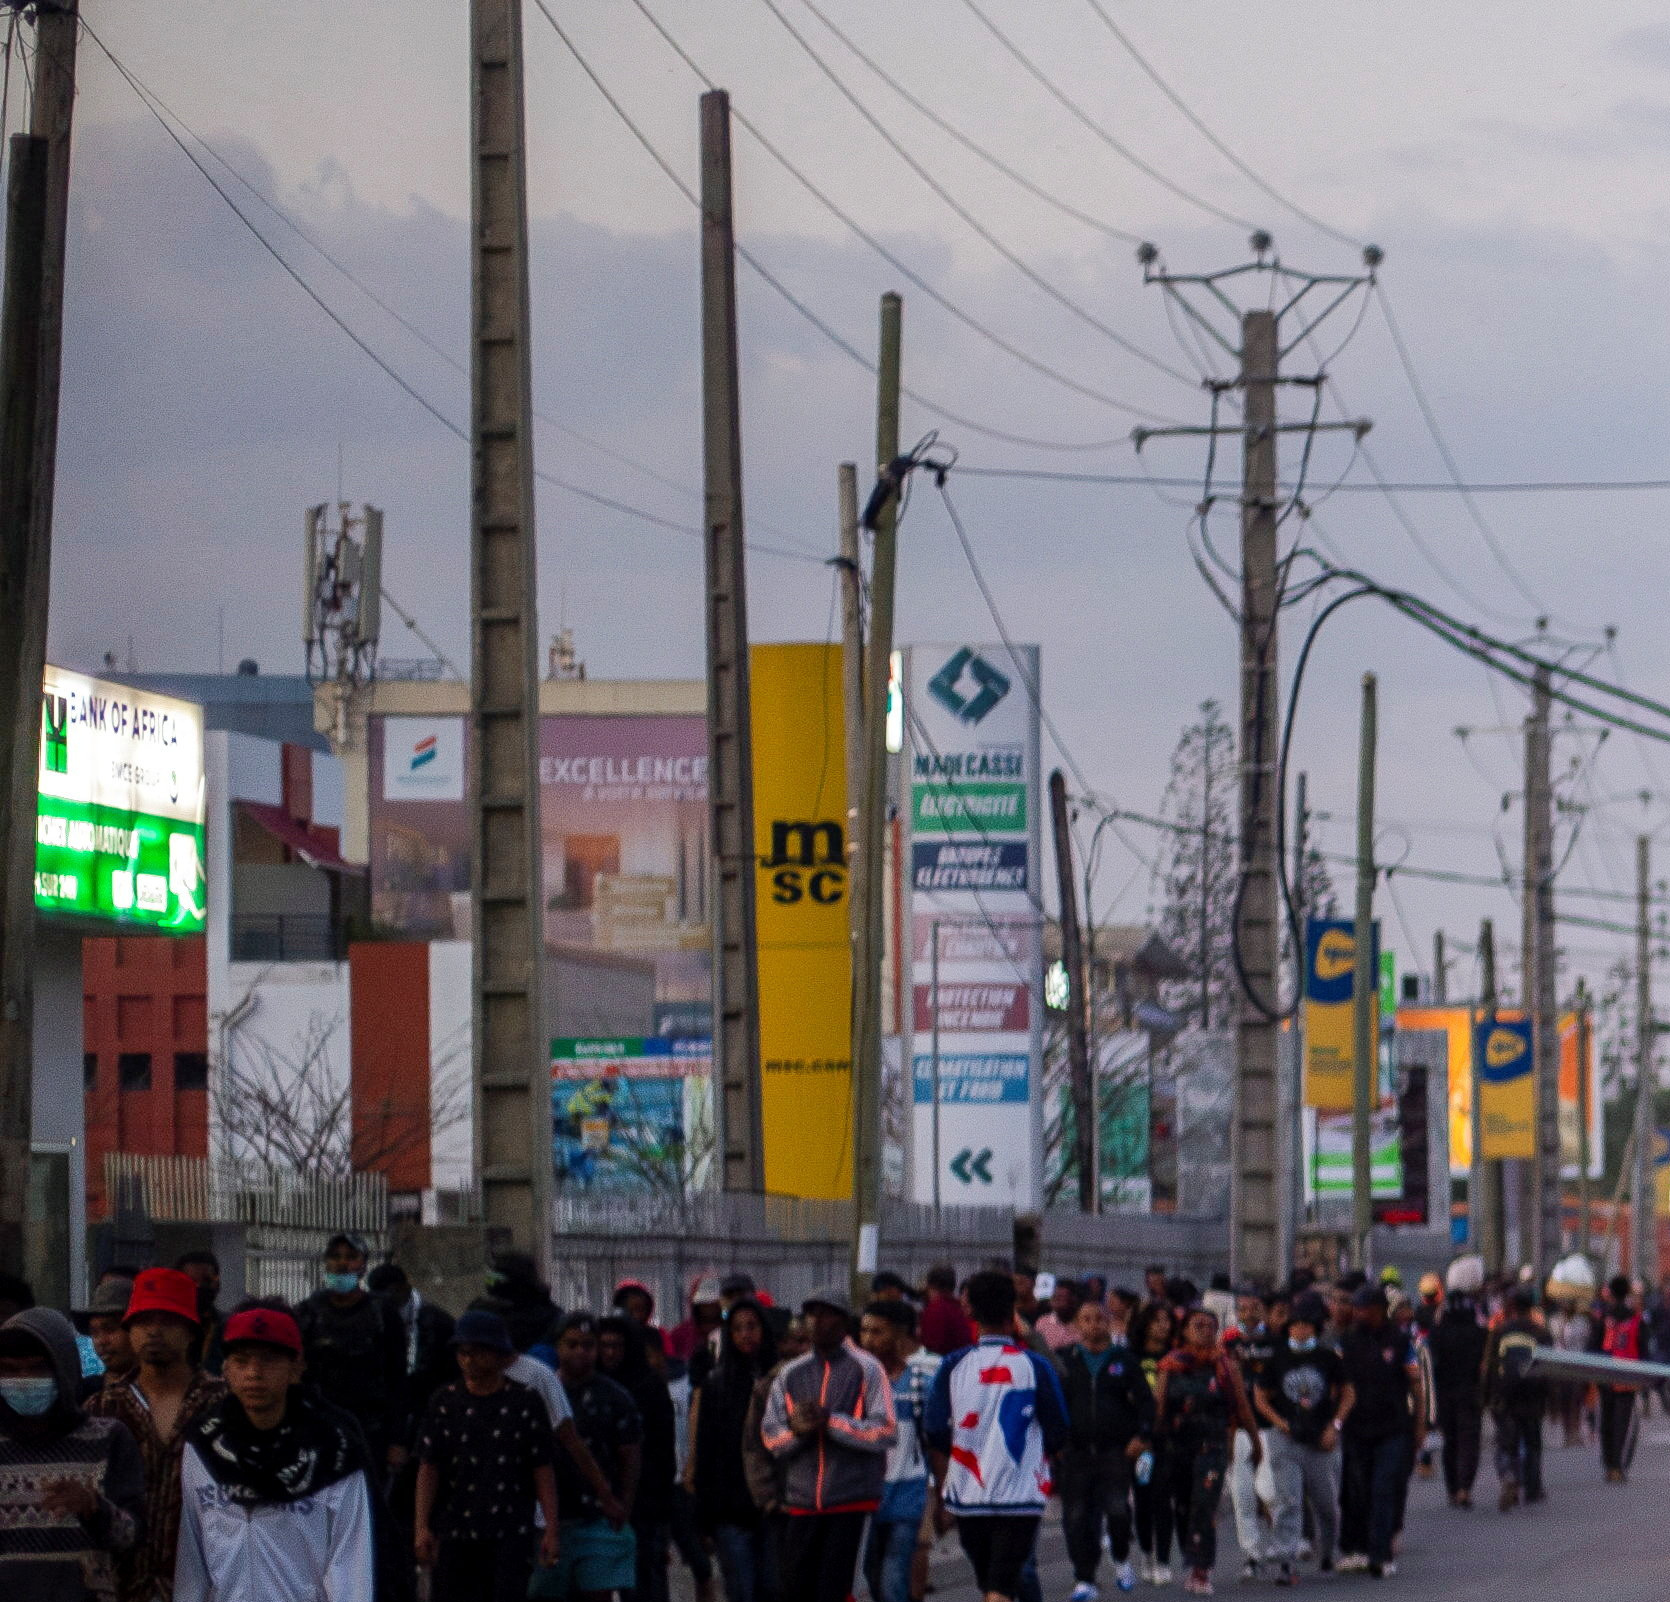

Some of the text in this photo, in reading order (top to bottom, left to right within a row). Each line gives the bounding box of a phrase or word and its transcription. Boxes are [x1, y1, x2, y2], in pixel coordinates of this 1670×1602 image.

[70, 691, 178, 746] BANK OF AFRICA
[539, 756, 708, 785] EXCELLENCE
